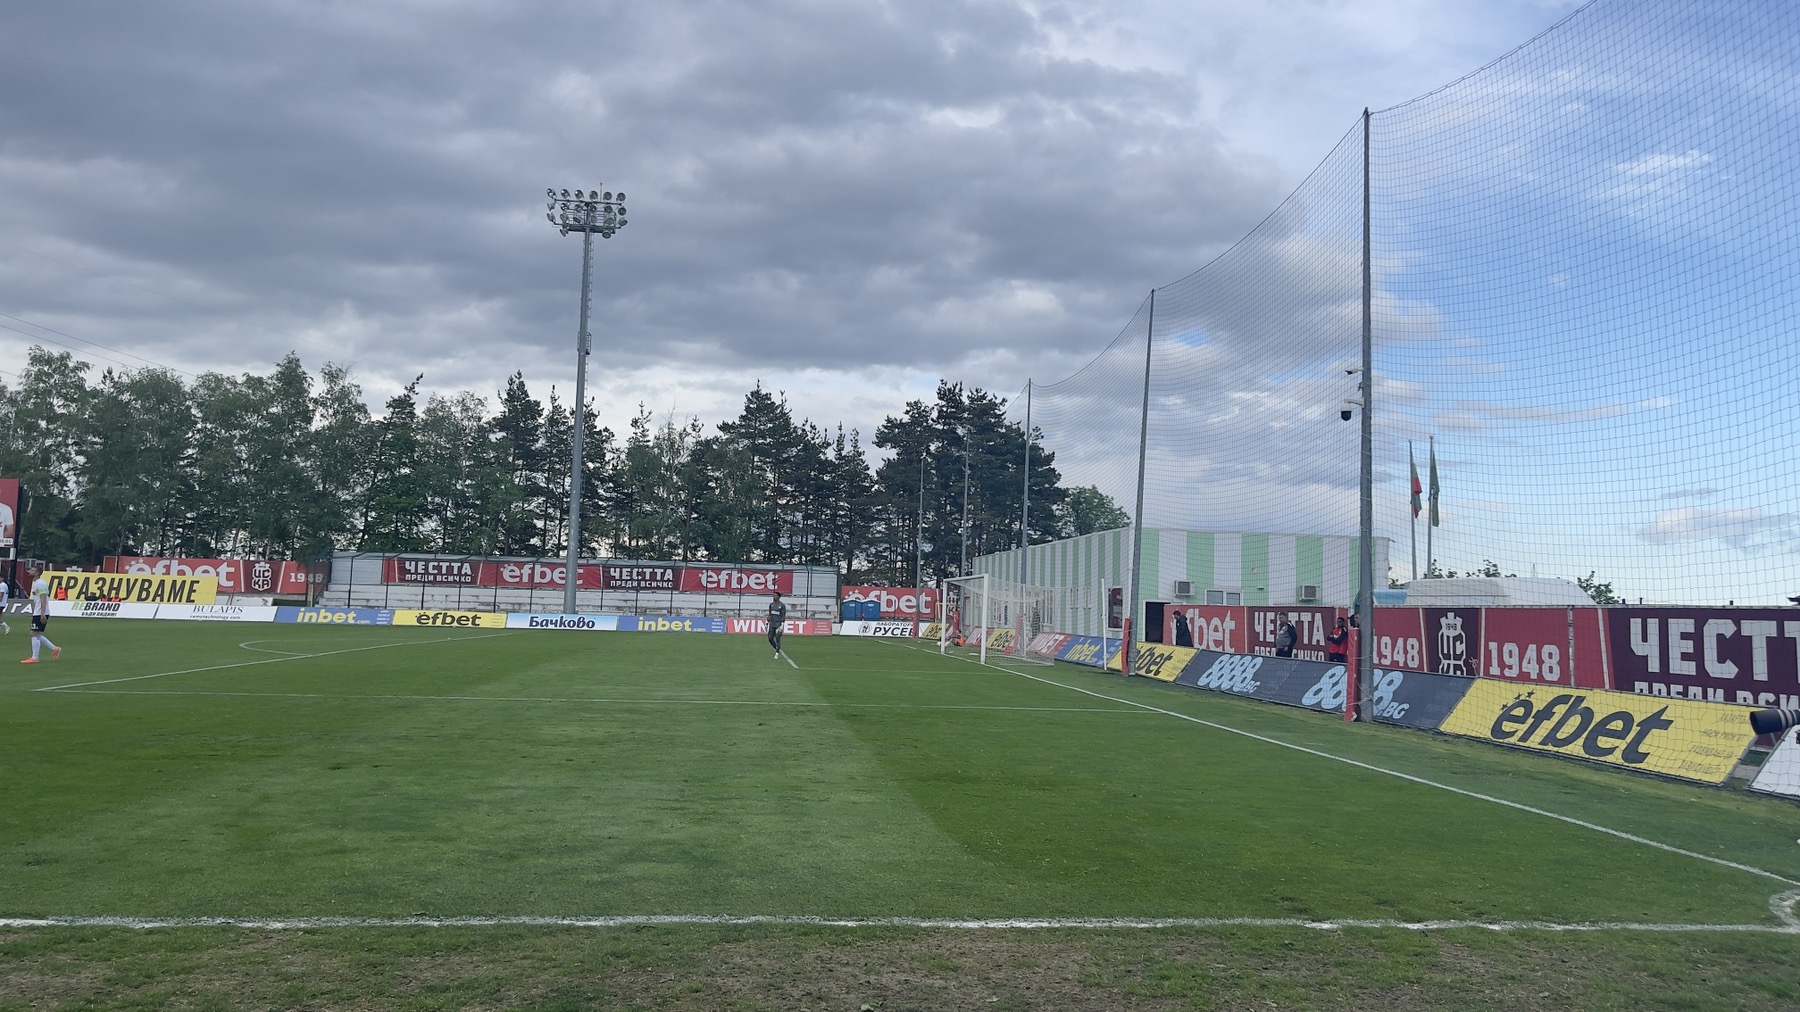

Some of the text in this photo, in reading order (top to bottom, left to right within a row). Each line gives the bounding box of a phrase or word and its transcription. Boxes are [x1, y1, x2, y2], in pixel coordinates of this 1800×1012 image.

[405, 561, 472, 575] ЧЕСТТА
[610, 567, 673, 580] ЧЕСТТА
[405, 574, 434, 582] ПРЕДИ
[610, 580, 673, 589] ПРЕДИ ВСИЧКО
[701, 569, 778, 590] efbet
[50, 575, 200, 604] ПРАЗНУВАМЕ
[71, 602, 121, 612] REBRAND
[415, 612, 481, 627] efbet
[529, 616, 596, 629] Бачково
[733, 620, 807, 635] WINET
[1254, 611, 1326, 646] ЧЕТТА
[1170, 608, 1236, 654] fbet
[1372, 635, 1420, 669] 1948
[1135, 646, 1174, 677] fbet
[1488, 641, 1561, 682] 1948
[1489, 694, 1674, 764] efbet
